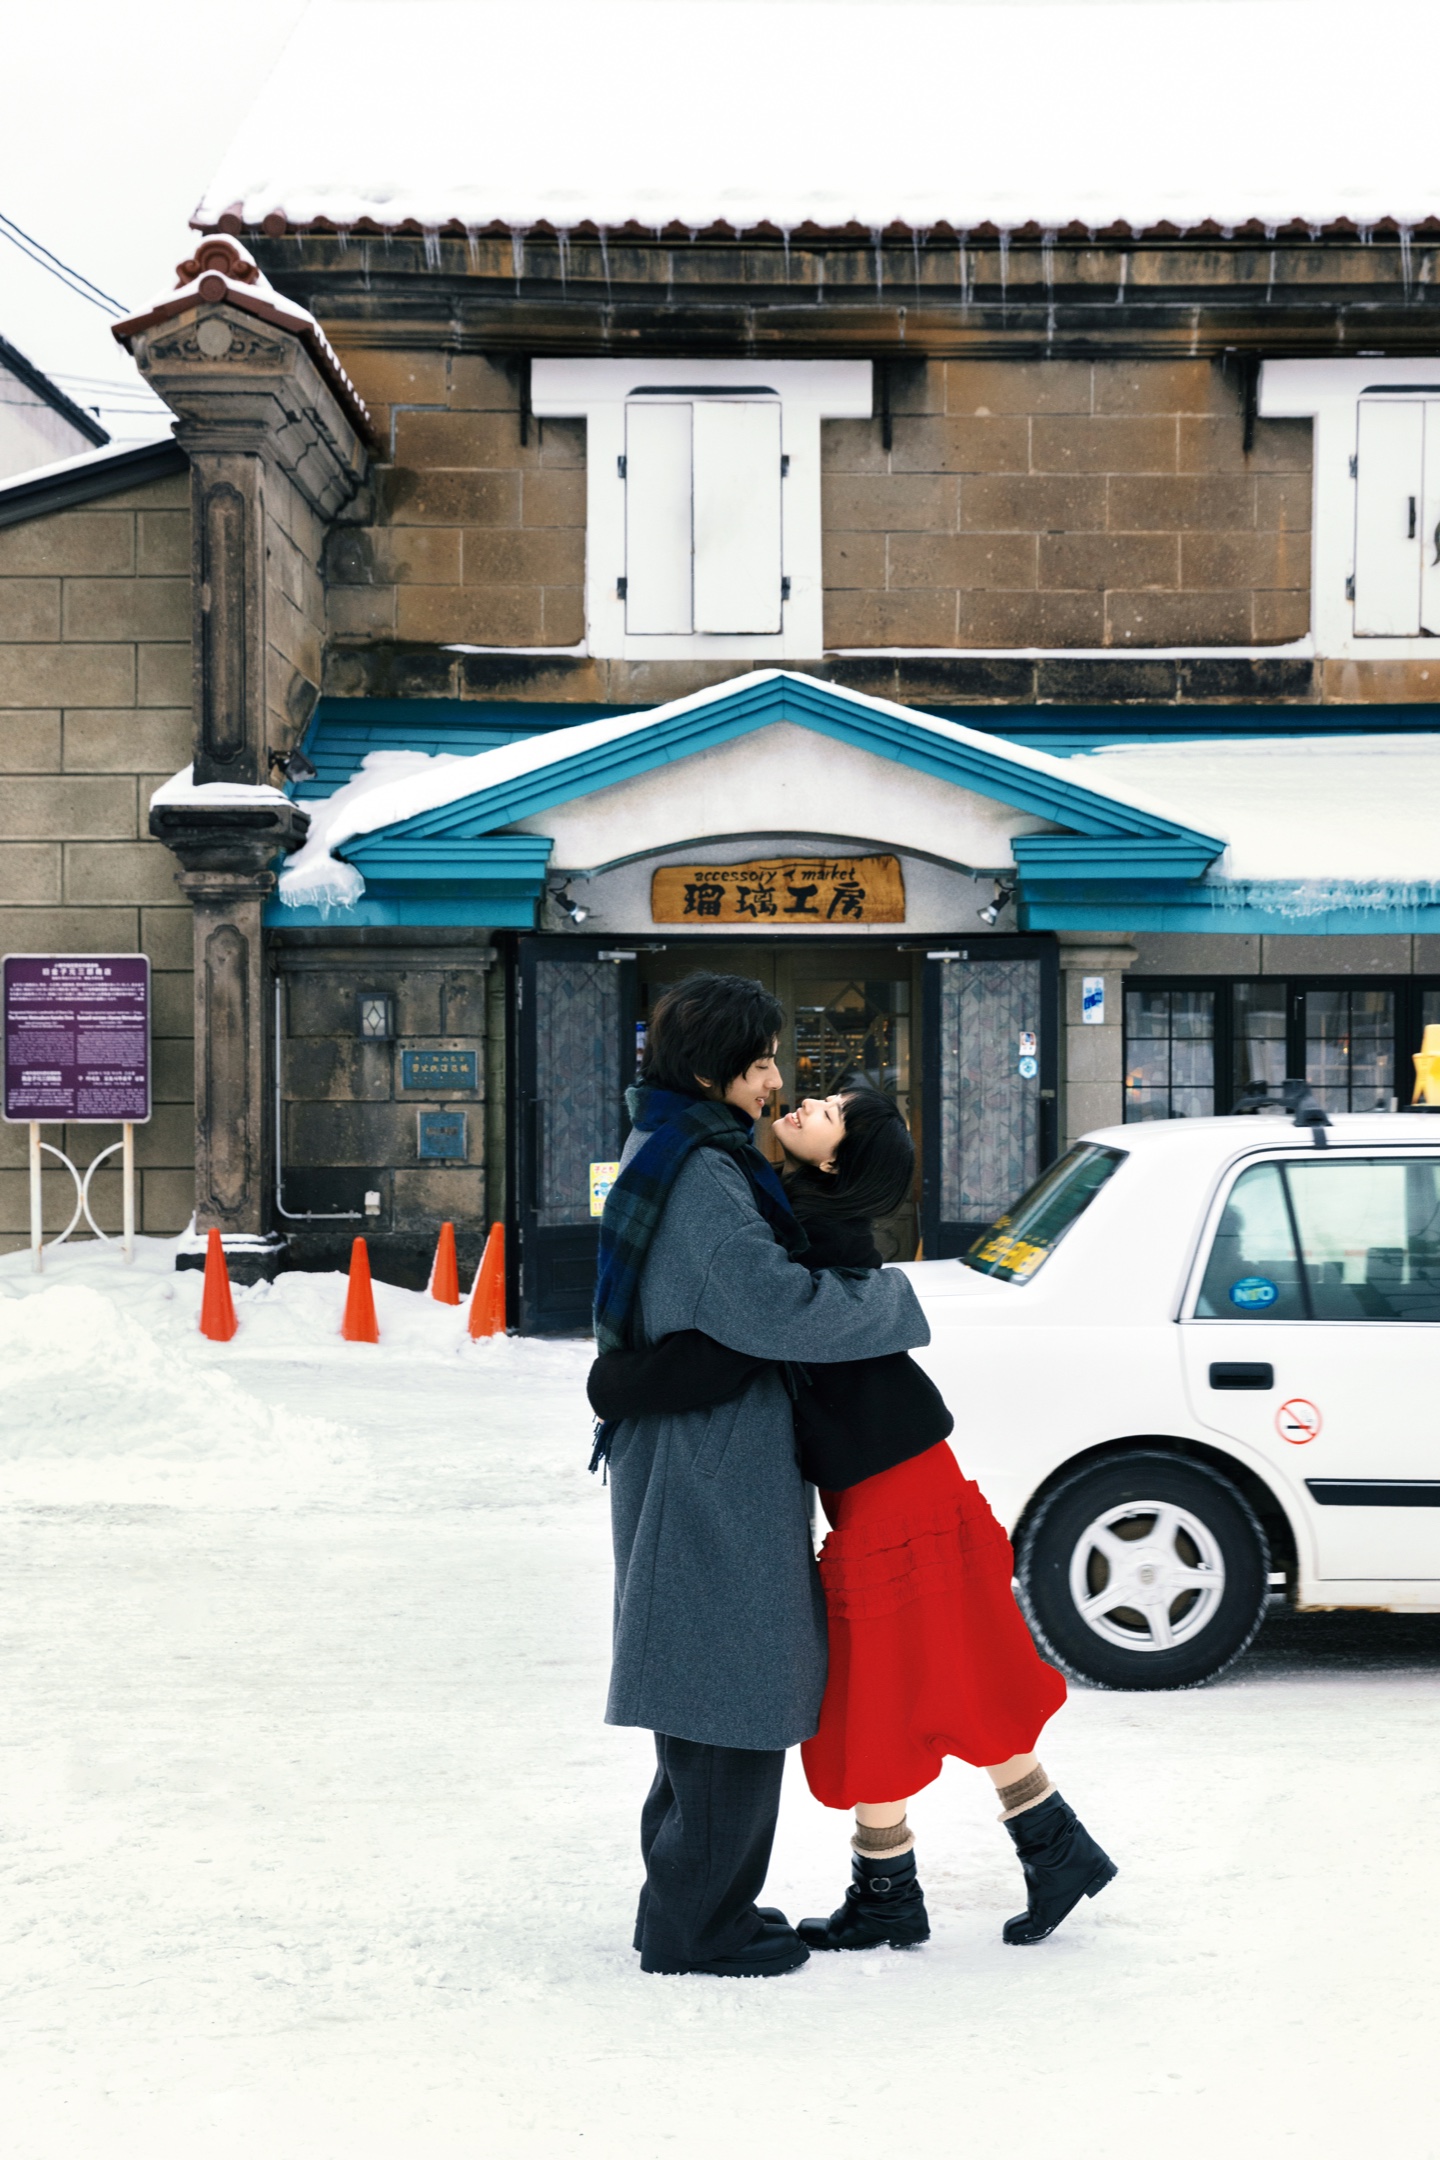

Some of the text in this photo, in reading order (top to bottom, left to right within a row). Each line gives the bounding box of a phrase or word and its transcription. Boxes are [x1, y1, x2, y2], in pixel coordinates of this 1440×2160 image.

[694, 864, 857, 885] accessory market
[683, 883, 867, 920] 瑠璃工房
